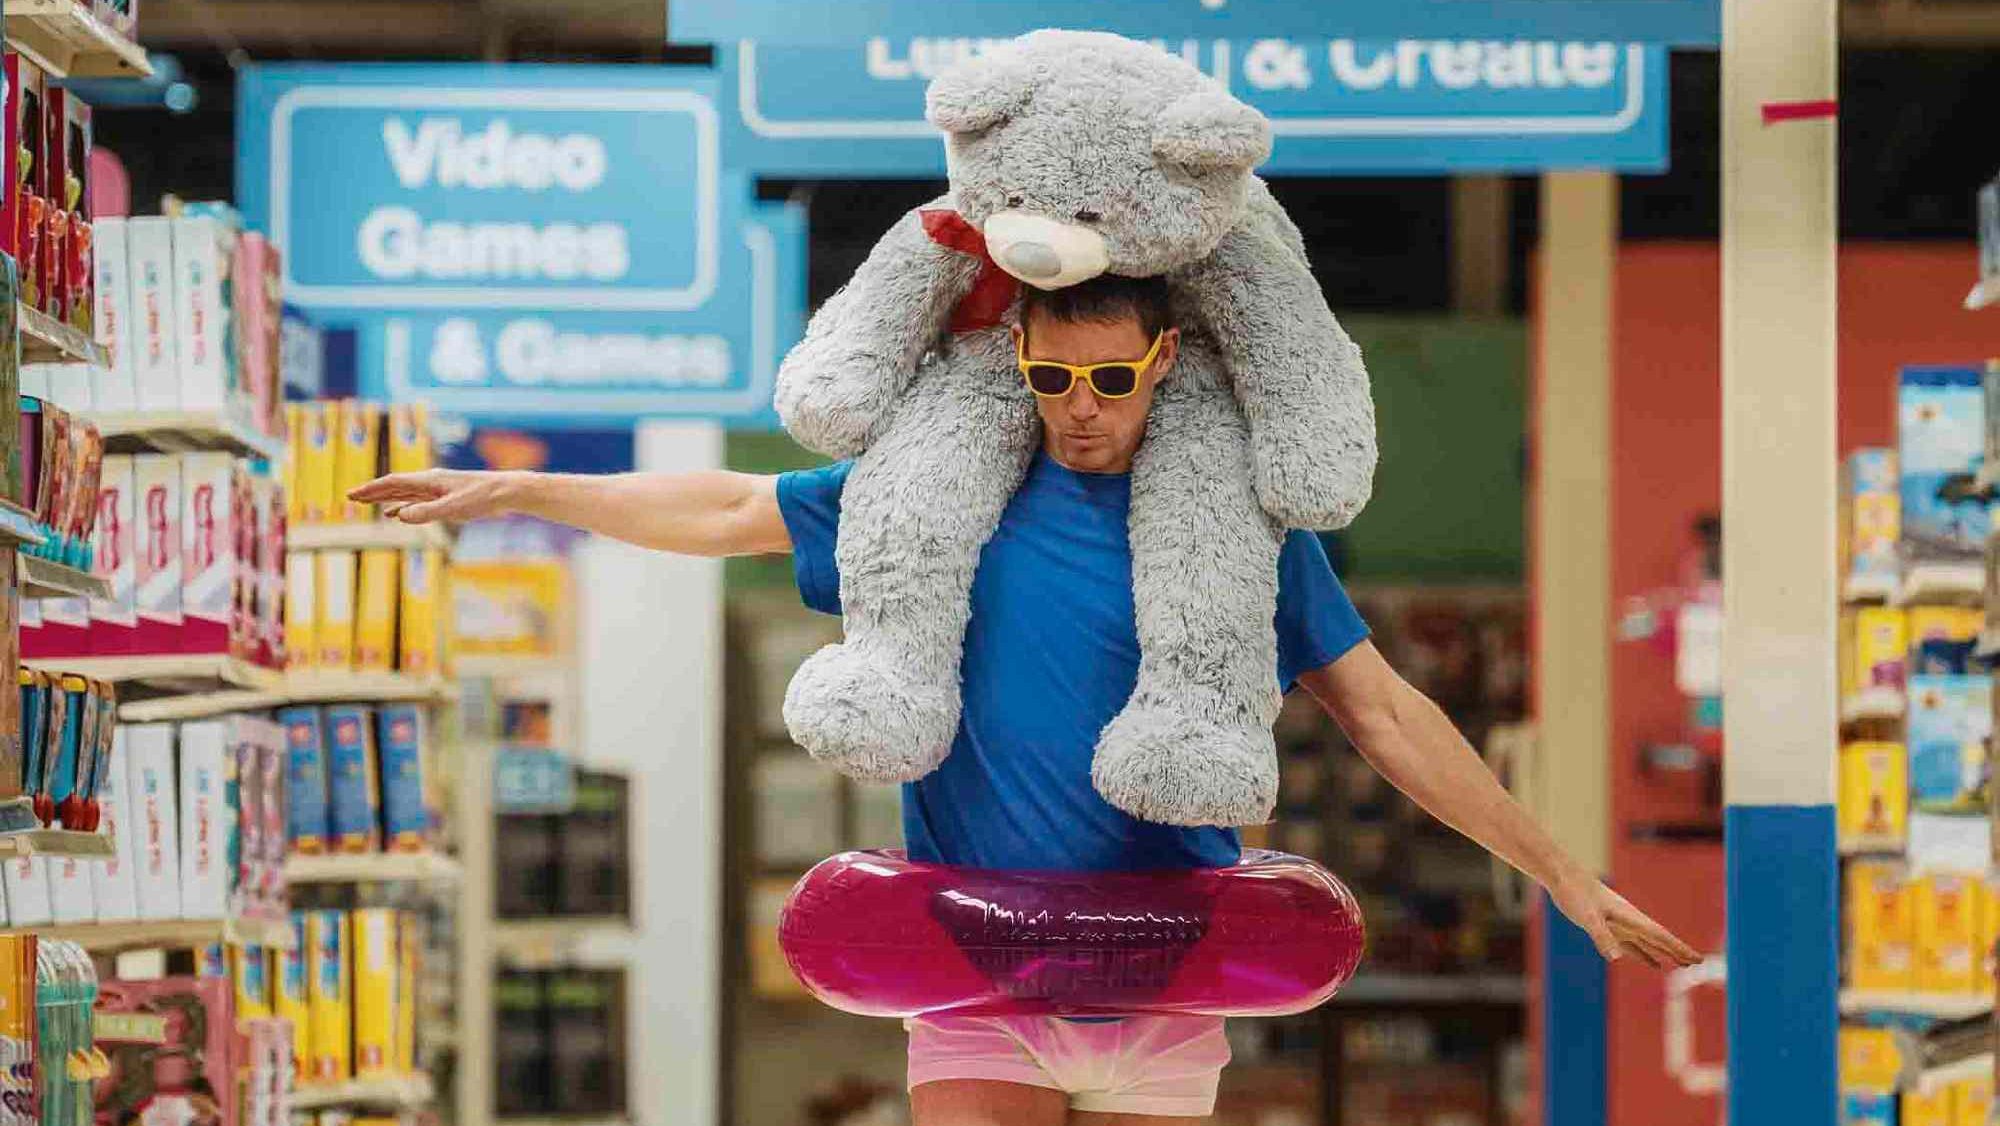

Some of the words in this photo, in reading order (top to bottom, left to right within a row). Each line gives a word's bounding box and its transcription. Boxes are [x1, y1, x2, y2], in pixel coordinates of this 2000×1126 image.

[1243, 38, 1312, 90] &
[1329, 38, 1616, 90] Create
[382, 117, 608, 192] Video
[358, 207, 630, 279] Games
[430, 317, 488, 383] &
[497, 319, 730, 384] Games
